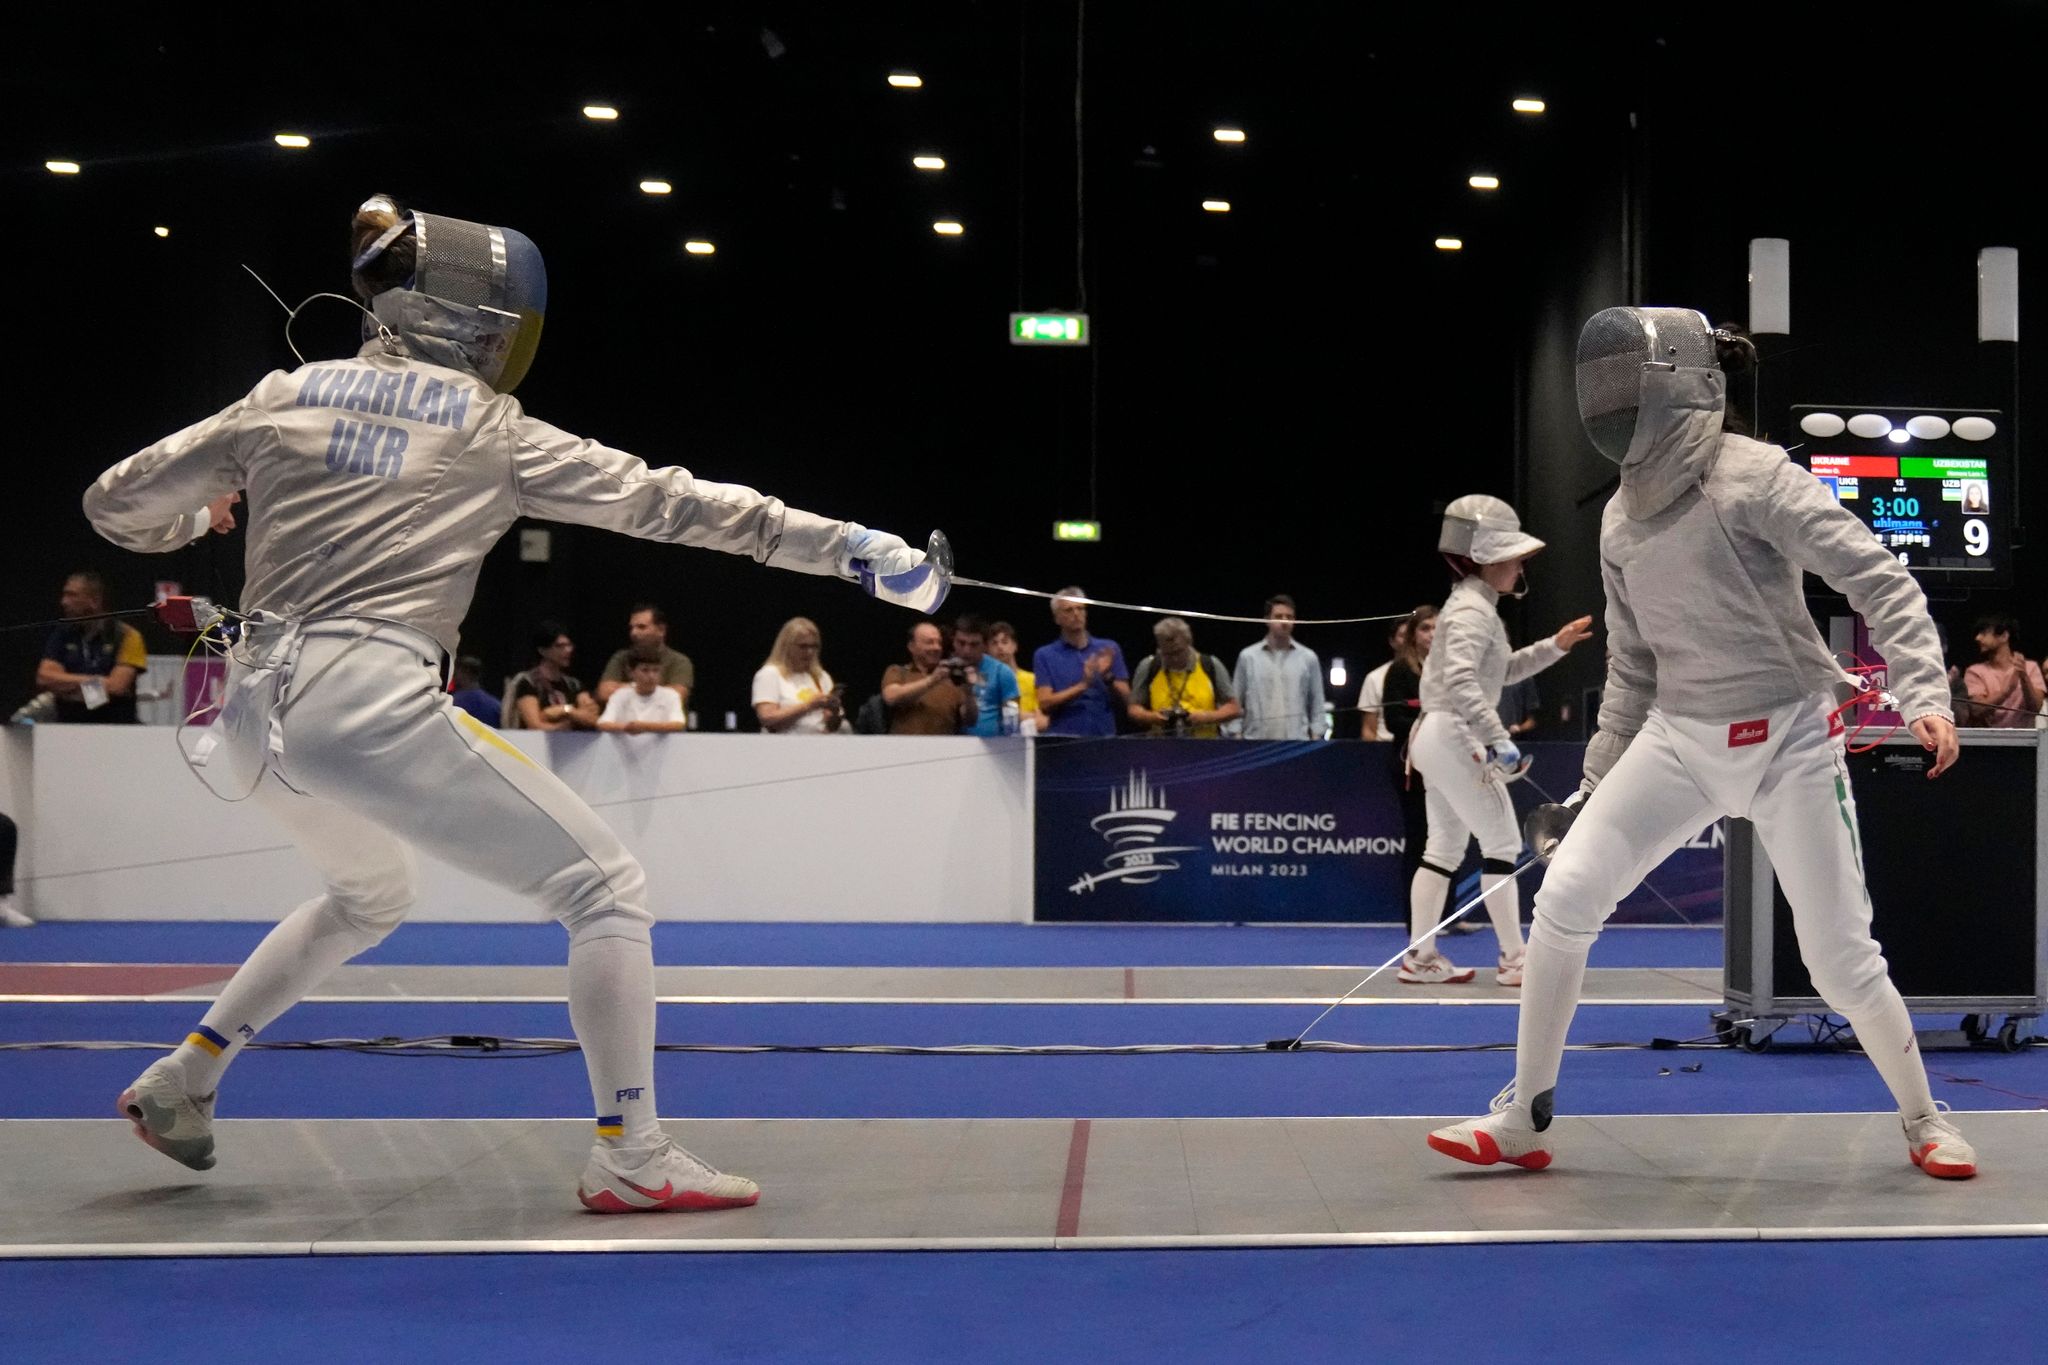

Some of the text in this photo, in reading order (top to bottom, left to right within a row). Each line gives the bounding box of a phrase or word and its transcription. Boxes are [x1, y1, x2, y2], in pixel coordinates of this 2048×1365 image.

[296, 368, 470, 431] KHARLAN
[325, 418, 409, 480] UKR
[1810, 456, 1850, 466] UKRAINE
[1932, 458, 1987, 468] UZBEKISTAN
[1839, 477, 1859, 486] UKR
[1942, 479, 1960, 488] UZB
[1872, 497, 1919, 516] 3:00
[1873, 517, 1923, 528] uhlmann
[1963, 518, 1990, 556] 9
[1211, 813, 1336, 831] FIE FENCING
[1212, 836, 1406, 855] WORLD CHAMPION
[1211, 864, 1308, 876] MILAN 2023
[616, 1087, 645, 1102] PBT
